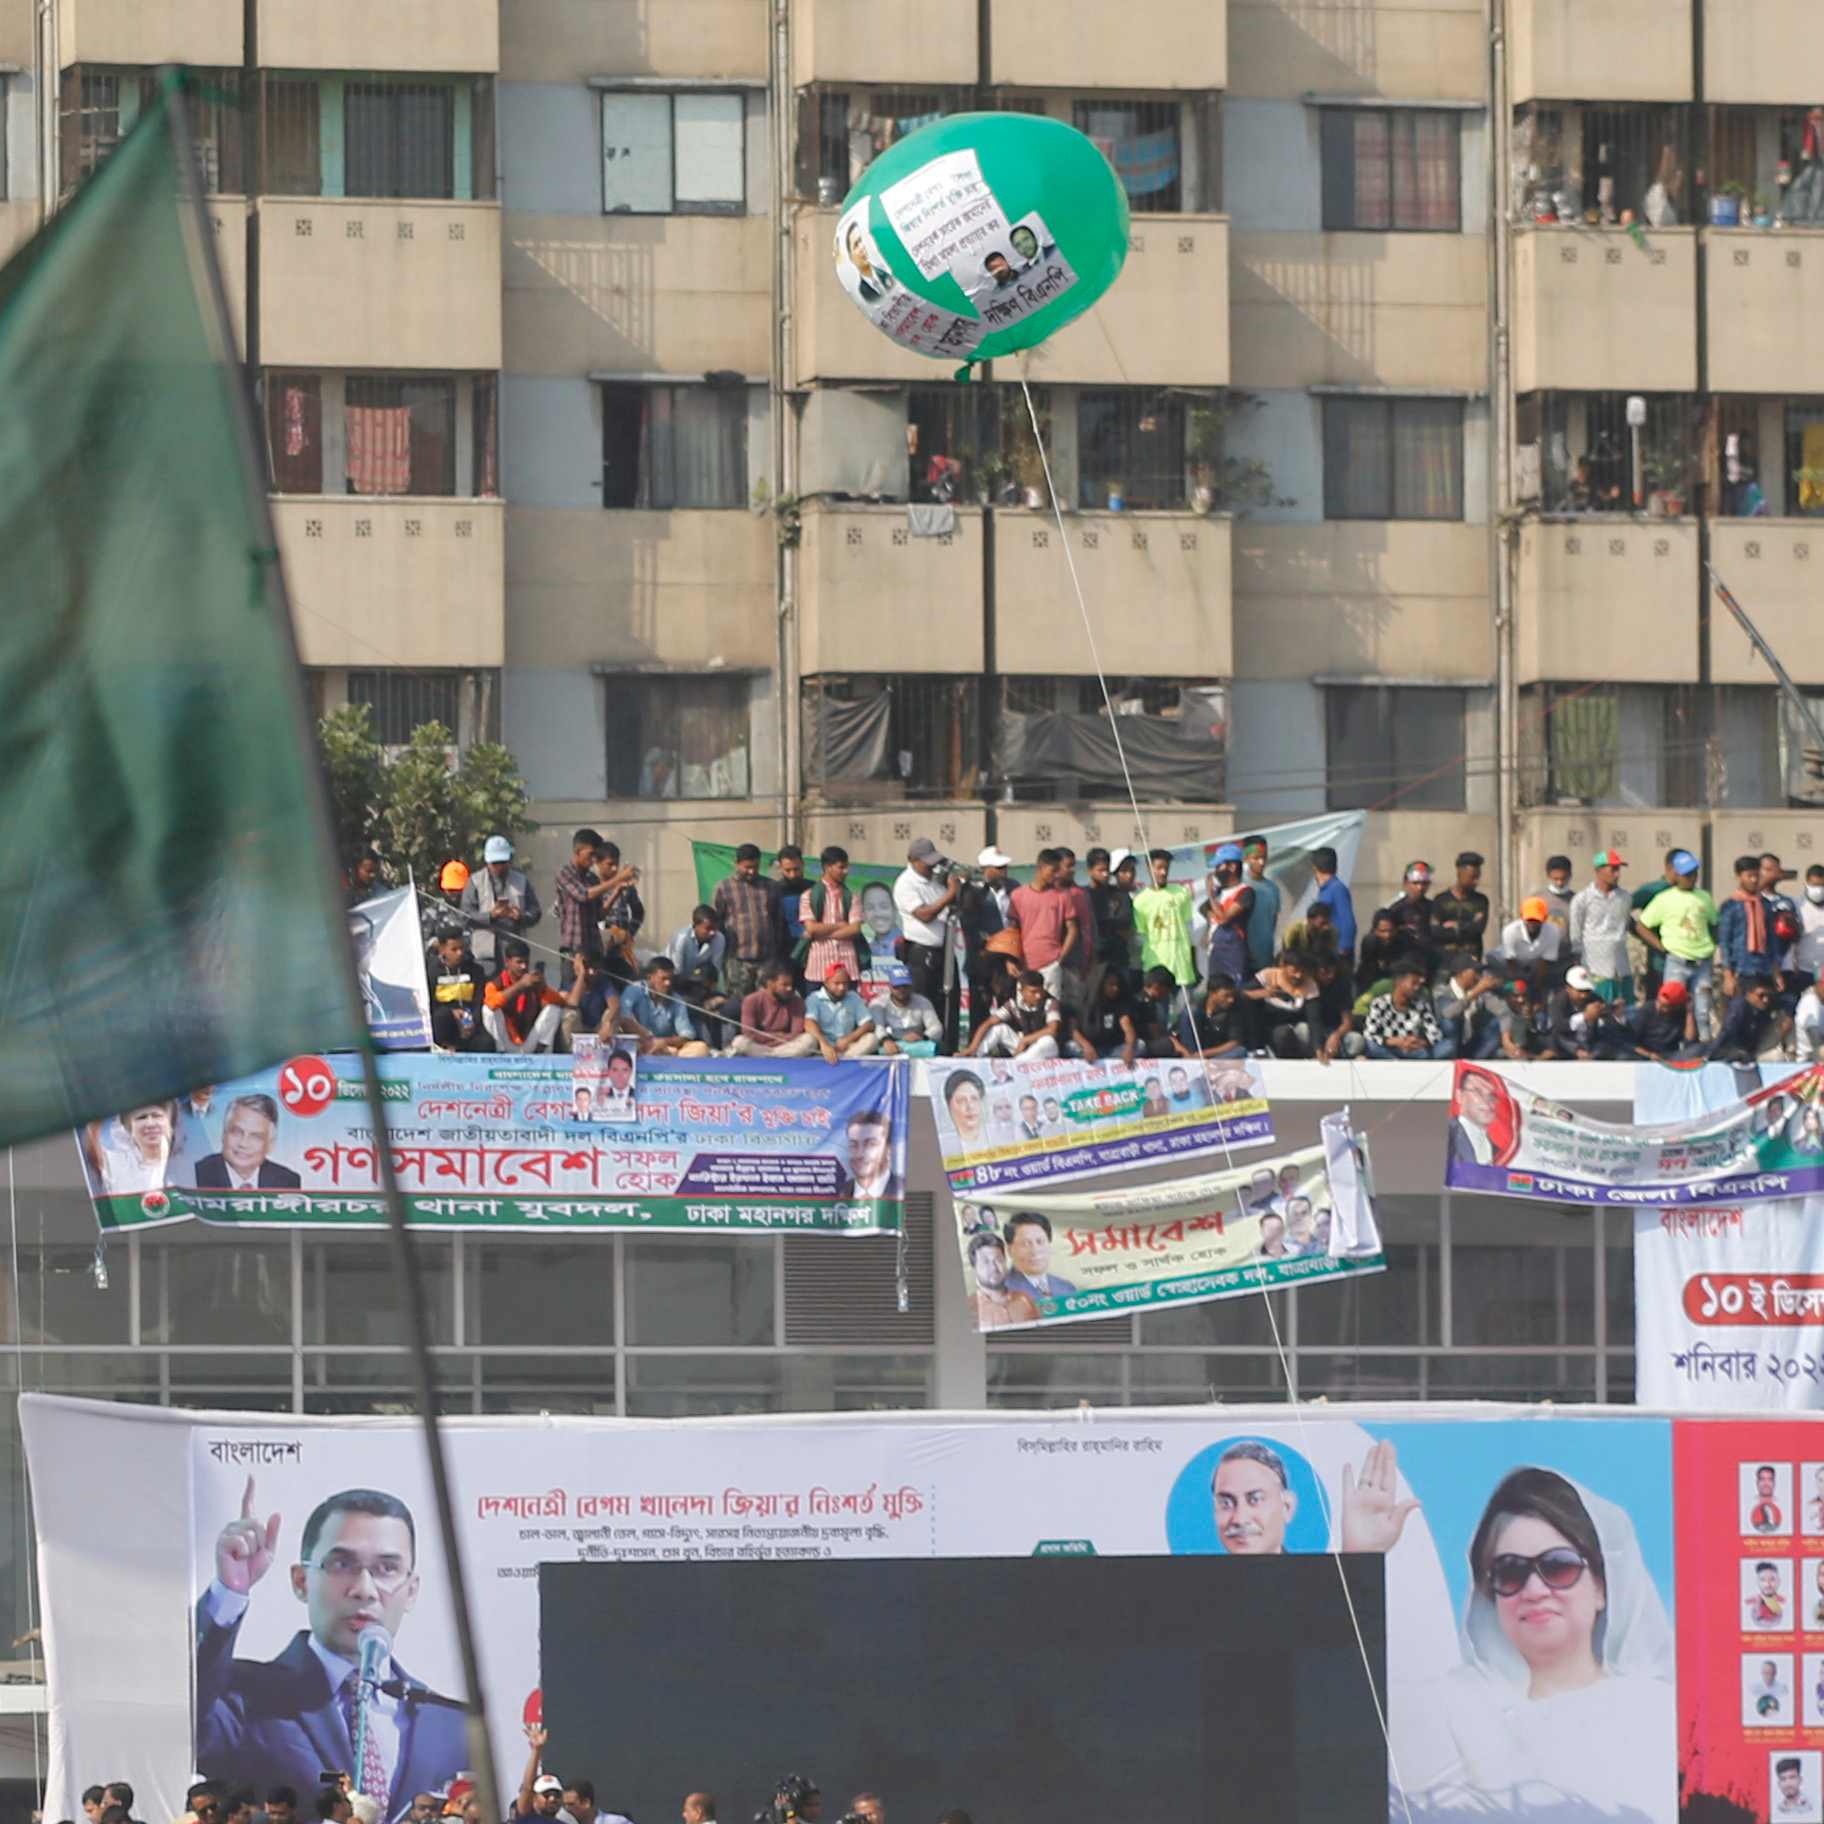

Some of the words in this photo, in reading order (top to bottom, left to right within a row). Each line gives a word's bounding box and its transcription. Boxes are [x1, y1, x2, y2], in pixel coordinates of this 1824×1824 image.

[284, 1067, 332, 1105] ১০
[418, 1094, 513, 1121] দেশনেত্রী
[1067, 1097, 1100, 1112] TAKE
[1103, 1089, 1141, 1104] BACK
[563, 1130, 594, 1145] দল
[613, 1149, 680, 1169] সফল
[616, 1170, 679, 1192] হোক
[413, 1198, 504, 1217] থানা
[684, 1203, 731, 1224] ঢাকা
[736, 1204, 814, 1225] মহানগর
[1065, 1209, 1226, 1257] সমাবেশ
[1699, 1276, 1744, 1318] ১০
[1747, 1279, 1769, 1321] ই
[1671, 1340, 1758, 1382] শনিবার
[207, 1438, 304, 1465] বাংলাদেশ
[477, 1487, 568, 1519] দেশনেত্রী
[576, 1494, 631, 1519] বেগম
[639, 1494, 714, 1519] খালেদা
[722, 1487, 800, 1519] জিয়া'র
[808, 1482, 878, 1516] নিঃশর্ত
[882, 1485, 924, 1520] মুক্তি
